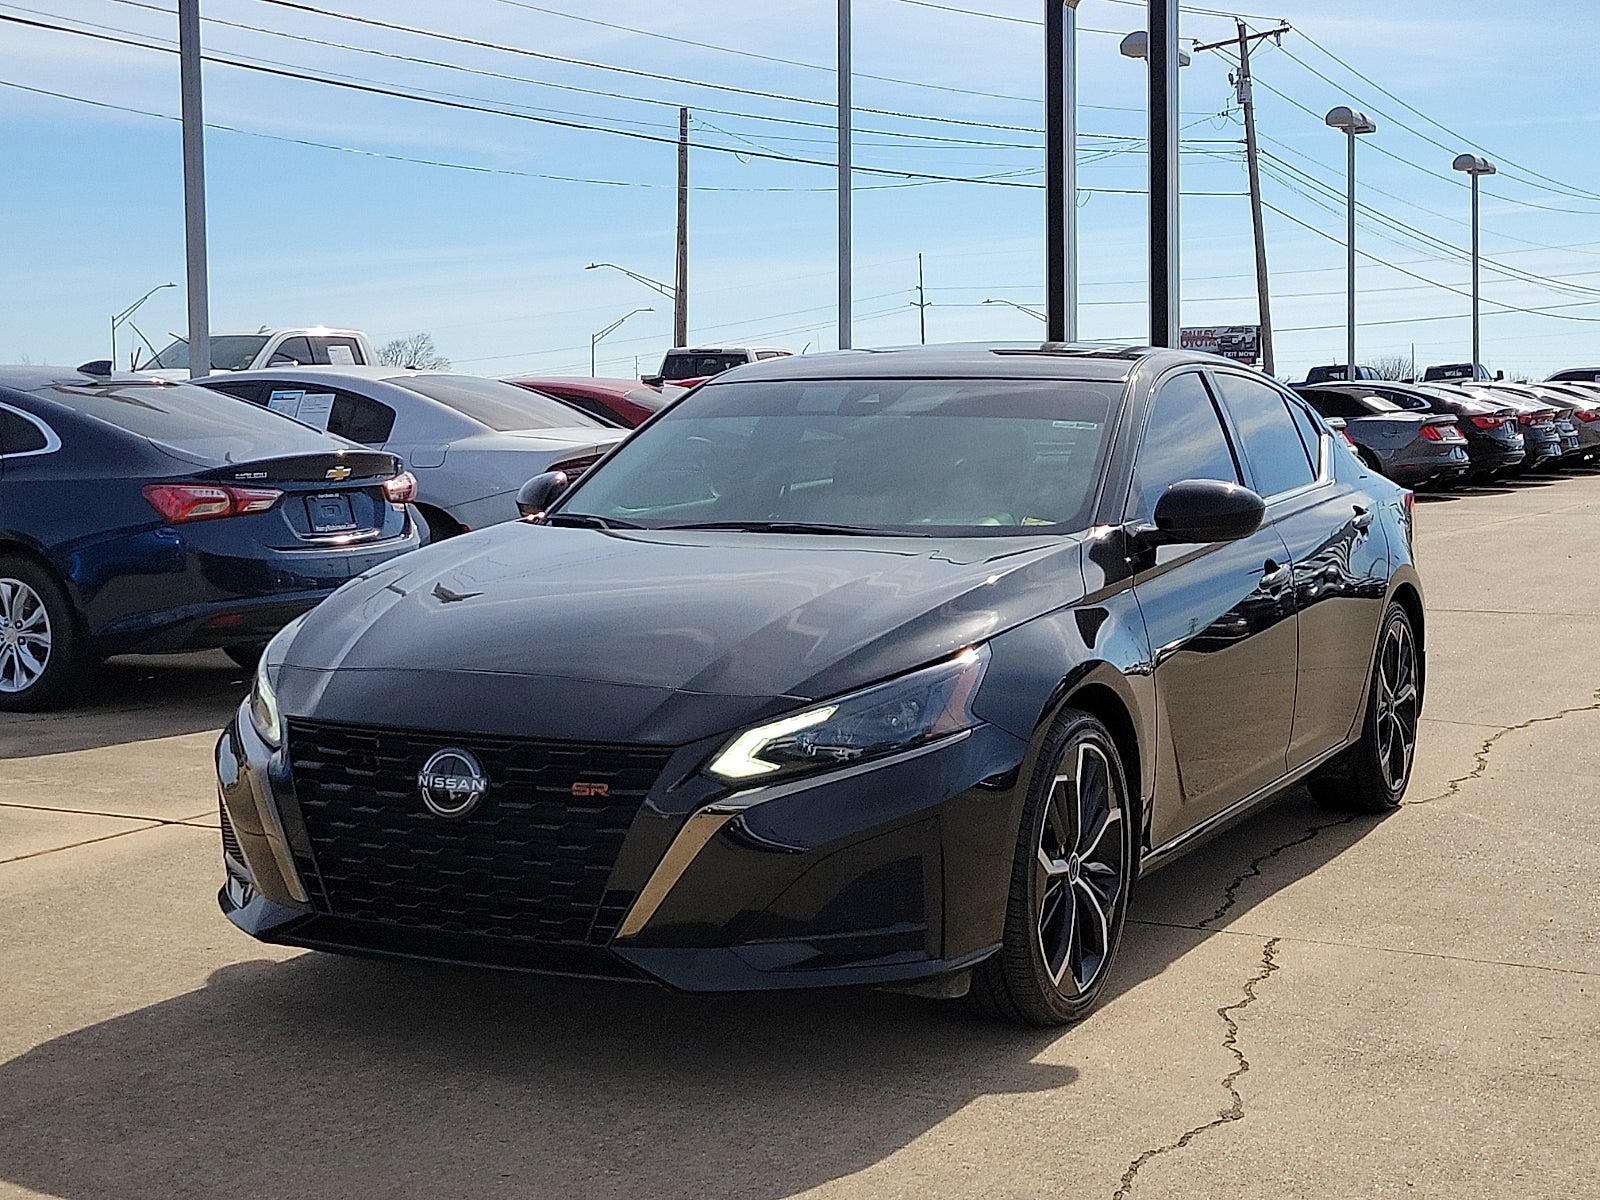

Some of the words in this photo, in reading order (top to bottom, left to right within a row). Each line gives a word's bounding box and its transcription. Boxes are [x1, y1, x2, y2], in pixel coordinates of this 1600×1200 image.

[1180, 336, 1217, 348] OYOTA
[418, 774, 486, 791] NISSAN
[571, 782, 609, 797] SR
